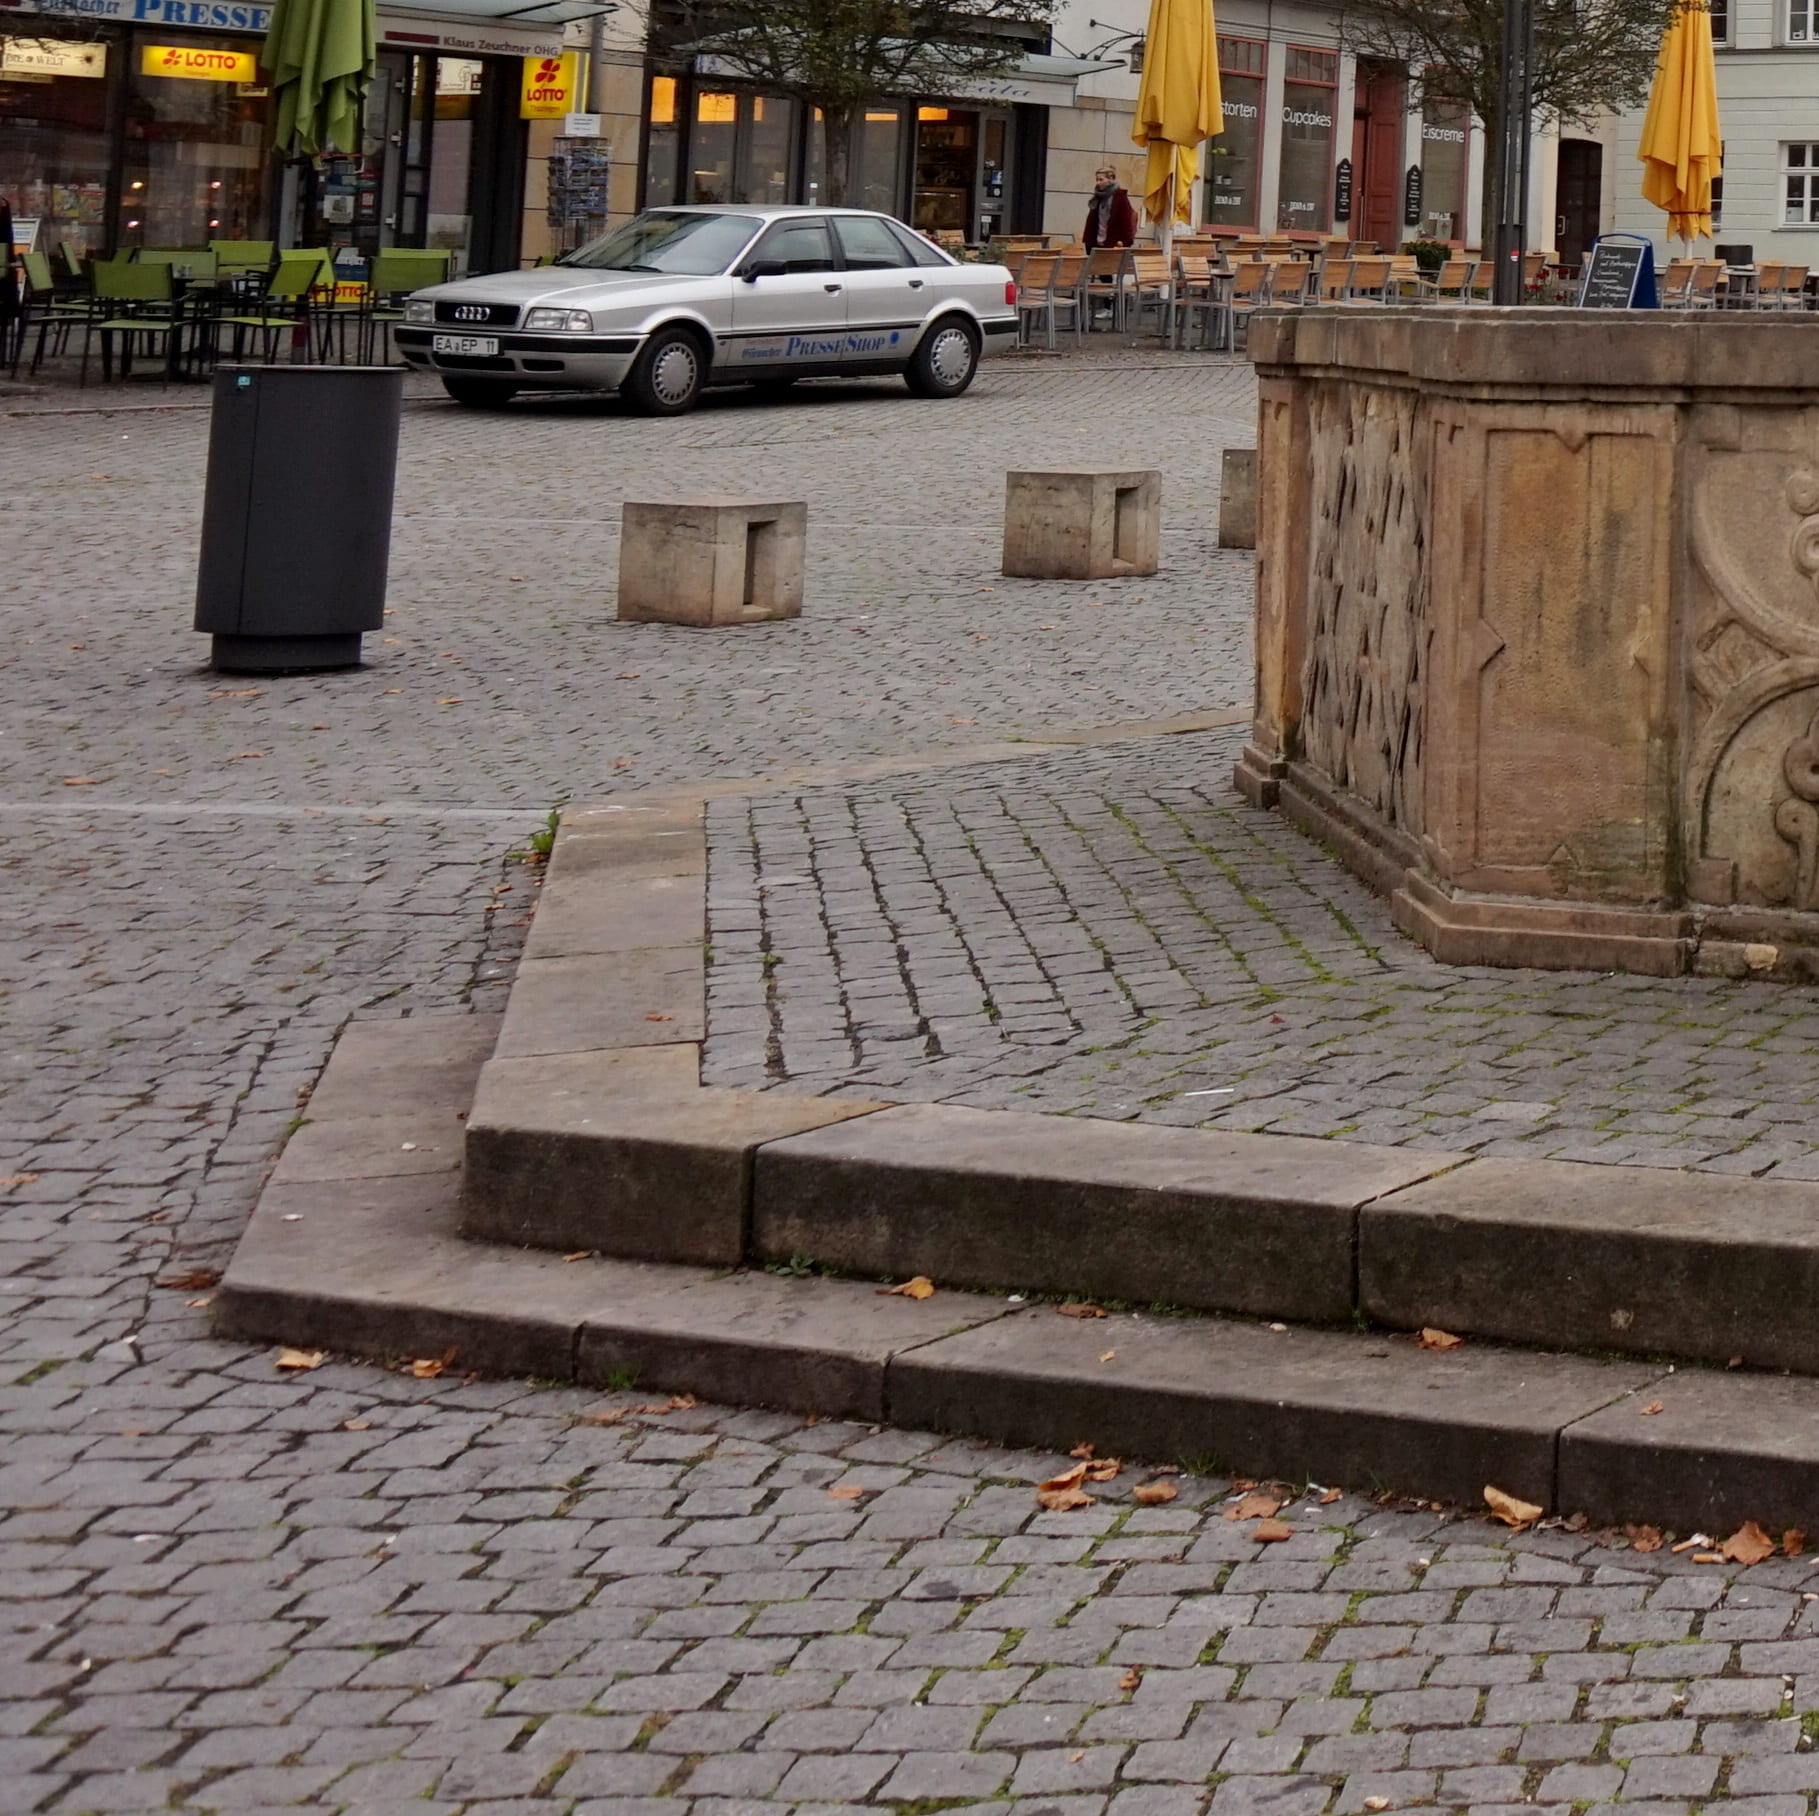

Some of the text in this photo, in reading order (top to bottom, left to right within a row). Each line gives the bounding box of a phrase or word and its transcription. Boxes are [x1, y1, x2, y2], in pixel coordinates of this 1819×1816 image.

[443, 36, 558, 56] Klaus Zeuchner OHG
[185, 51, 236, 69] LOTTO
[527, 88, 565, 101] LOTTO
[1282, 106, 1332, 127] Cupcakes
[1422, 123, 1465, 143] Eiscreme
[436, 337, 495, 353] EA EP 11
